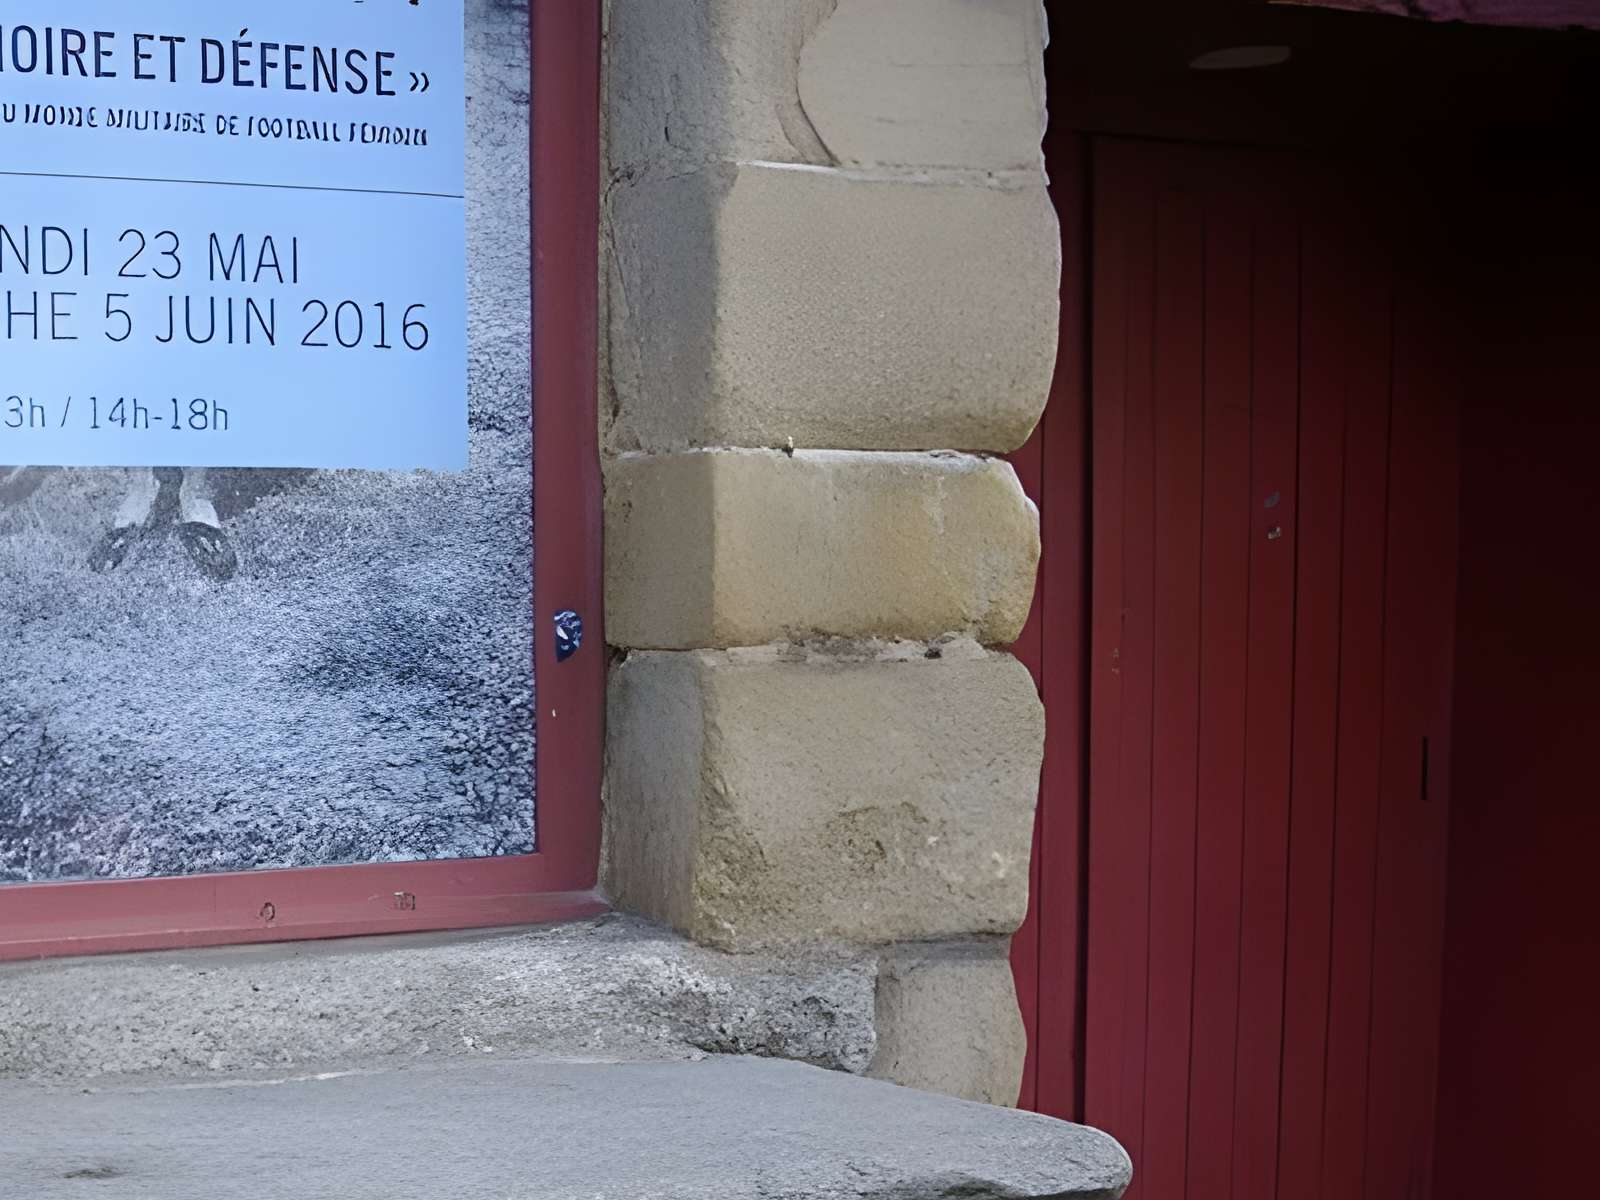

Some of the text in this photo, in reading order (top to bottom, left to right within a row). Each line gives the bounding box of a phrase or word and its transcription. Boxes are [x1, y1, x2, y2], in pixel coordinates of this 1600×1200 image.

[132, 33, 186, 83] ET
[200, 27, 397, 97] DÉFENSE
[215, 114, 240, 136] DE
[117, 228, 182, 280] 23
[209, 231, 298, 284] MAI
[104, 292, 132, 343] 5
[154, 295, 276, 347] JUIN
[300, 299, 429, 352] 2016
[89, 396, 228, 431] 14h-18h
